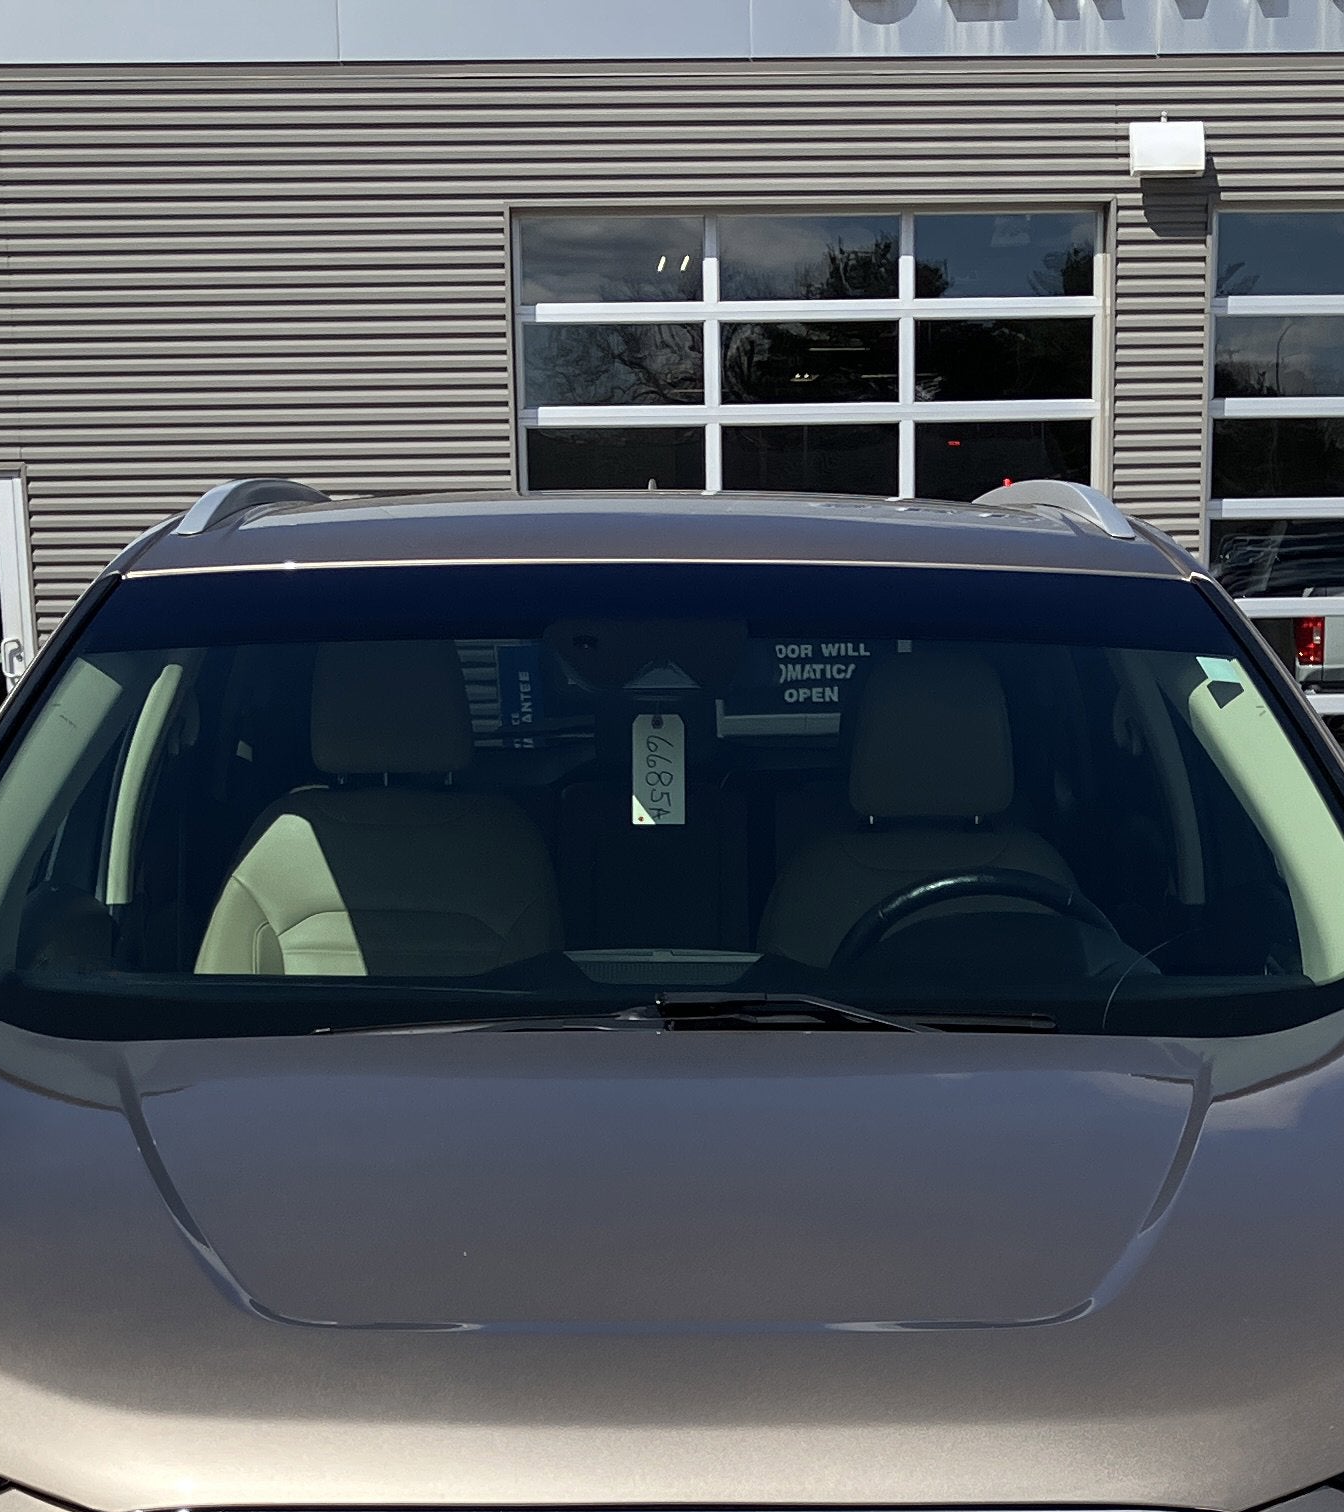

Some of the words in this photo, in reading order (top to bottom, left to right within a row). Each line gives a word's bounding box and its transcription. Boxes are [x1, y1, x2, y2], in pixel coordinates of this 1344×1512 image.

[821, 642, 871, 657] WILL
[784, 686, 839, 703] OPEN
[644, 734, 674, 822] 6685A
